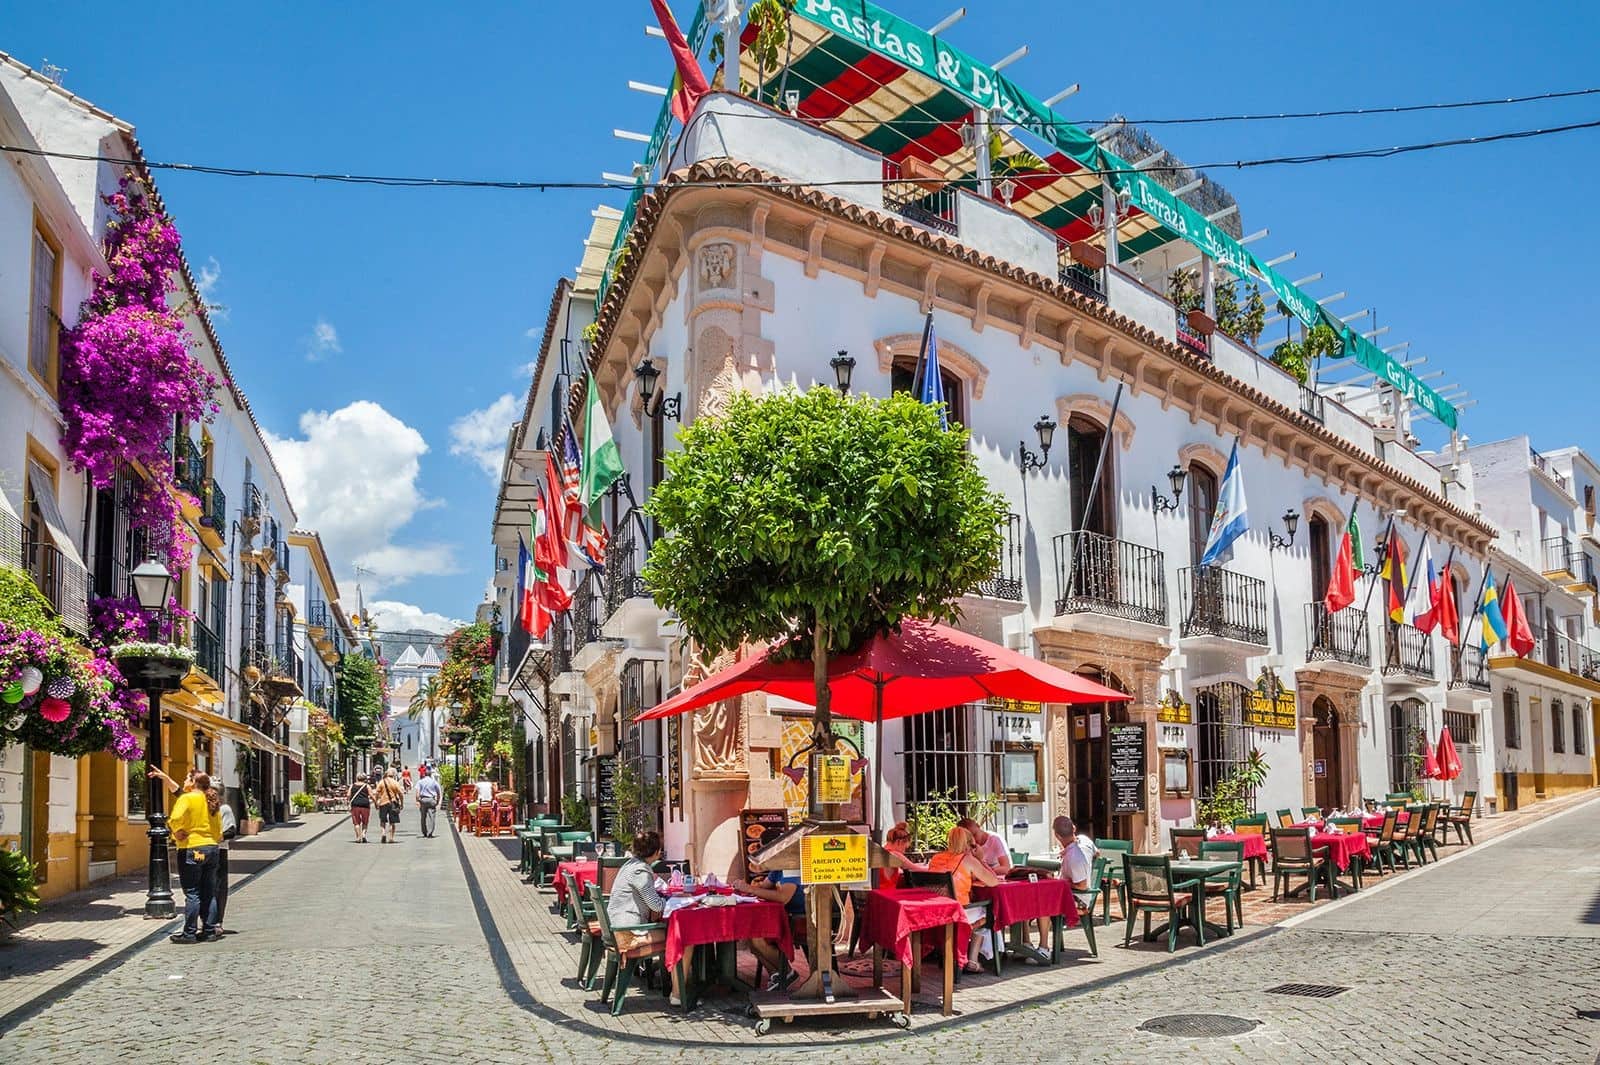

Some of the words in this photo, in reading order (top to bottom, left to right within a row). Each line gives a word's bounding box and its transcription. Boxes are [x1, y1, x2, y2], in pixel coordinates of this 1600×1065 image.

[935, 51, 961, 88] &
[971, 66, 1057, 147] Pizzas
[1137, 179, 1188, 235] Terraza
